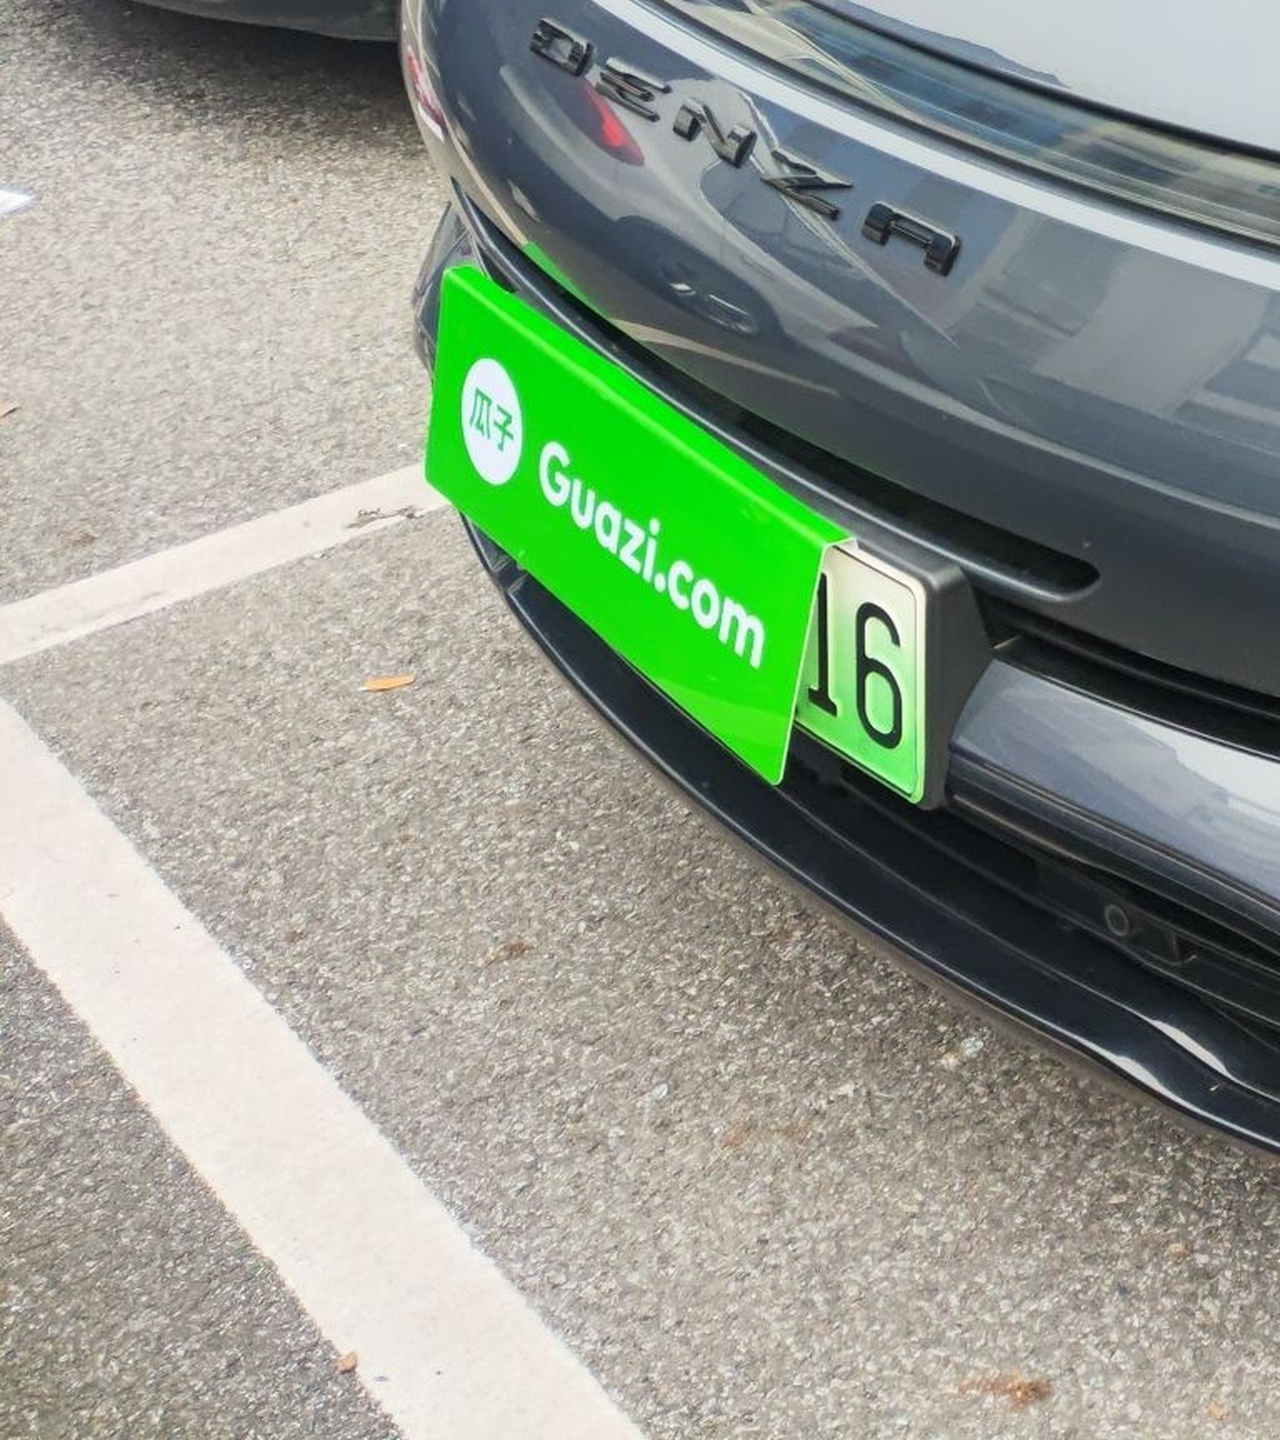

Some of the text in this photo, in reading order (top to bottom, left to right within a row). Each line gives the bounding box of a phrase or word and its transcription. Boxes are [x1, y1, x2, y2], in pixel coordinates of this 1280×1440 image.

[528, 16, 962, 278] DENZA
[469, 386, 516, 452] 瓜子
[539, 440, 765, 670] Guazi.com
